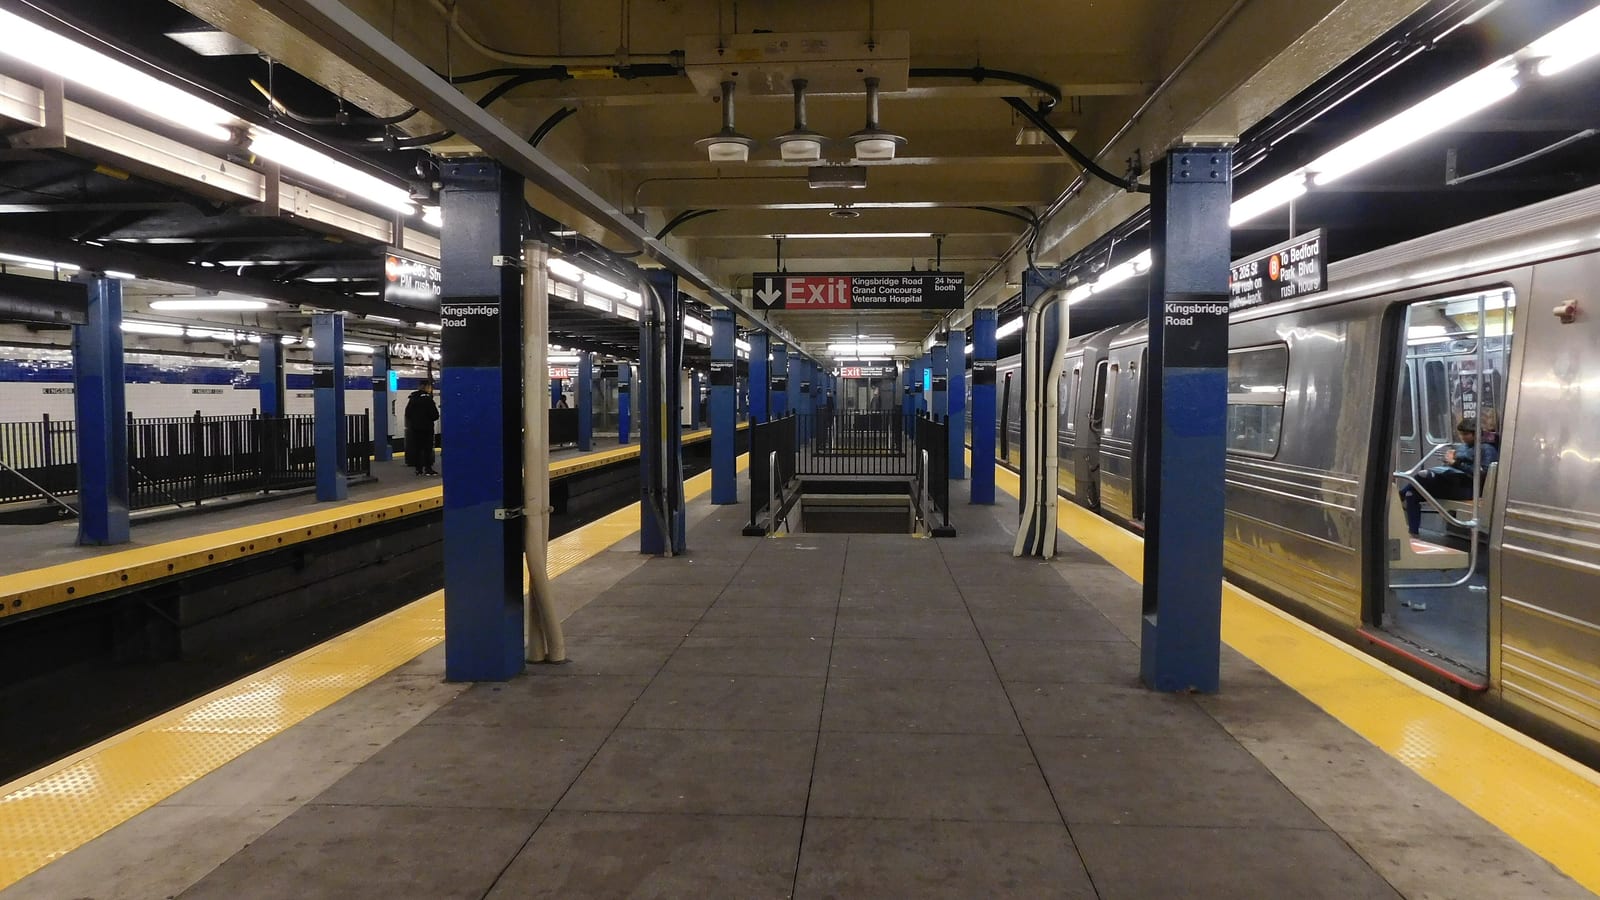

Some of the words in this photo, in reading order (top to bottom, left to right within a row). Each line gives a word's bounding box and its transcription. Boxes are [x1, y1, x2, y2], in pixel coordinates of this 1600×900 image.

[1279, 251, 1288, 266] To
[1290, 239, 1319, 263] Bedford
[1280, 265, 1295, 282] Park
[1298, 258, 1313, 277] Blvd
[401, 274, 412, 289] PM
[851, 277, 899, 287] Kingsbridge
[901, 277, 923, 286] Road
[934, 277, 944, 285] 24
[946, 277, 963, 285] hour
[1254, 277, 1263, 289] on
[785, 278, 847, 304] Exit
[852, 286, 876, 294] Grand
[878, 286, 922, 294] Concourse
[1280, 282, 1295, 298] rush
[852, 295, 887, 303] Veterans
[889, 295, 923, 304] Hospital
[440, 305, 499, 317] Kingsbridge
[1165, 303, 1229, 316] Kingsbridge
[441, 317, 467, 327] Road
[1165, 316, 1193, 326] Road
[548, 368, 568, 377] Exit
[841, 367, 860, 377] Exit
